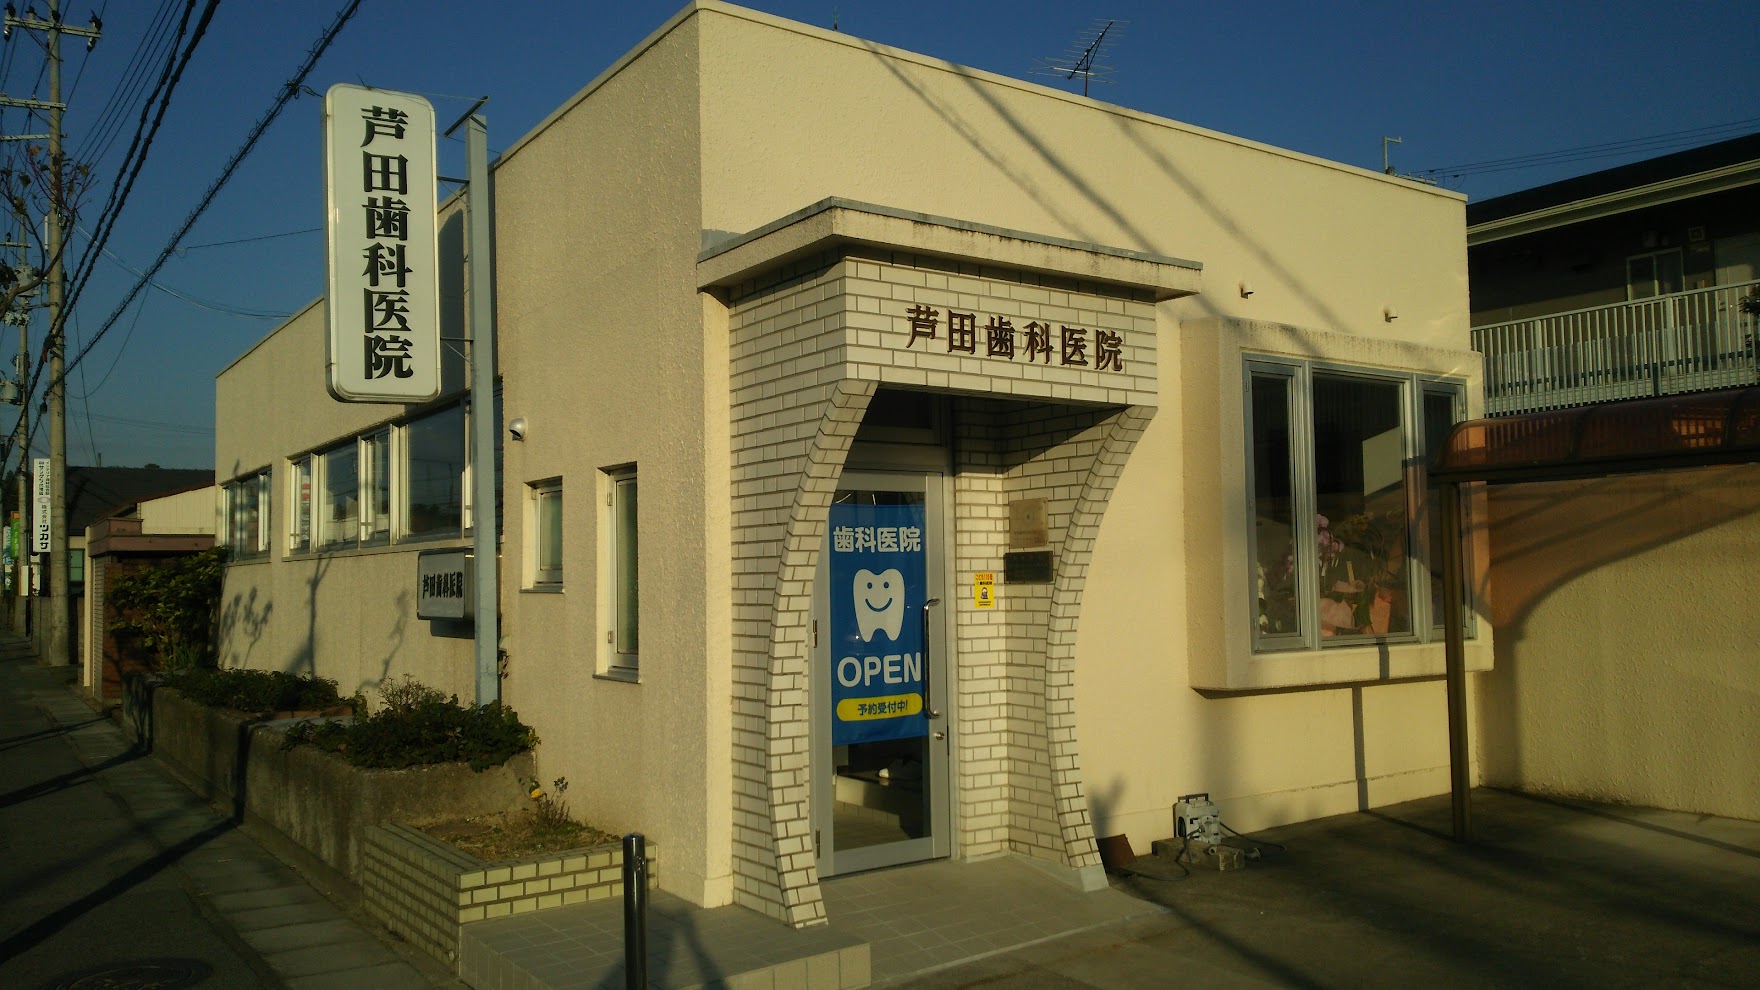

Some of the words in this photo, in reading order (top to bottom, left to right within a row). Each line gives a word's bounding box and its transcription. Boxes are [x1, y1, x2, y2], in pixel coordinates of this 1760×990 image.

[360, 105, 414, 380] 芦田歯科医院
[905, 304, 1124, 372] 芦田歯科医院
[833, 526, 922, 553] 歯科医院
[422, 571, 463, 599] 芦田歯科医院
[837, 652, 922, 688] OPEN
[857, 699, 908, 716] 予約受付中!
